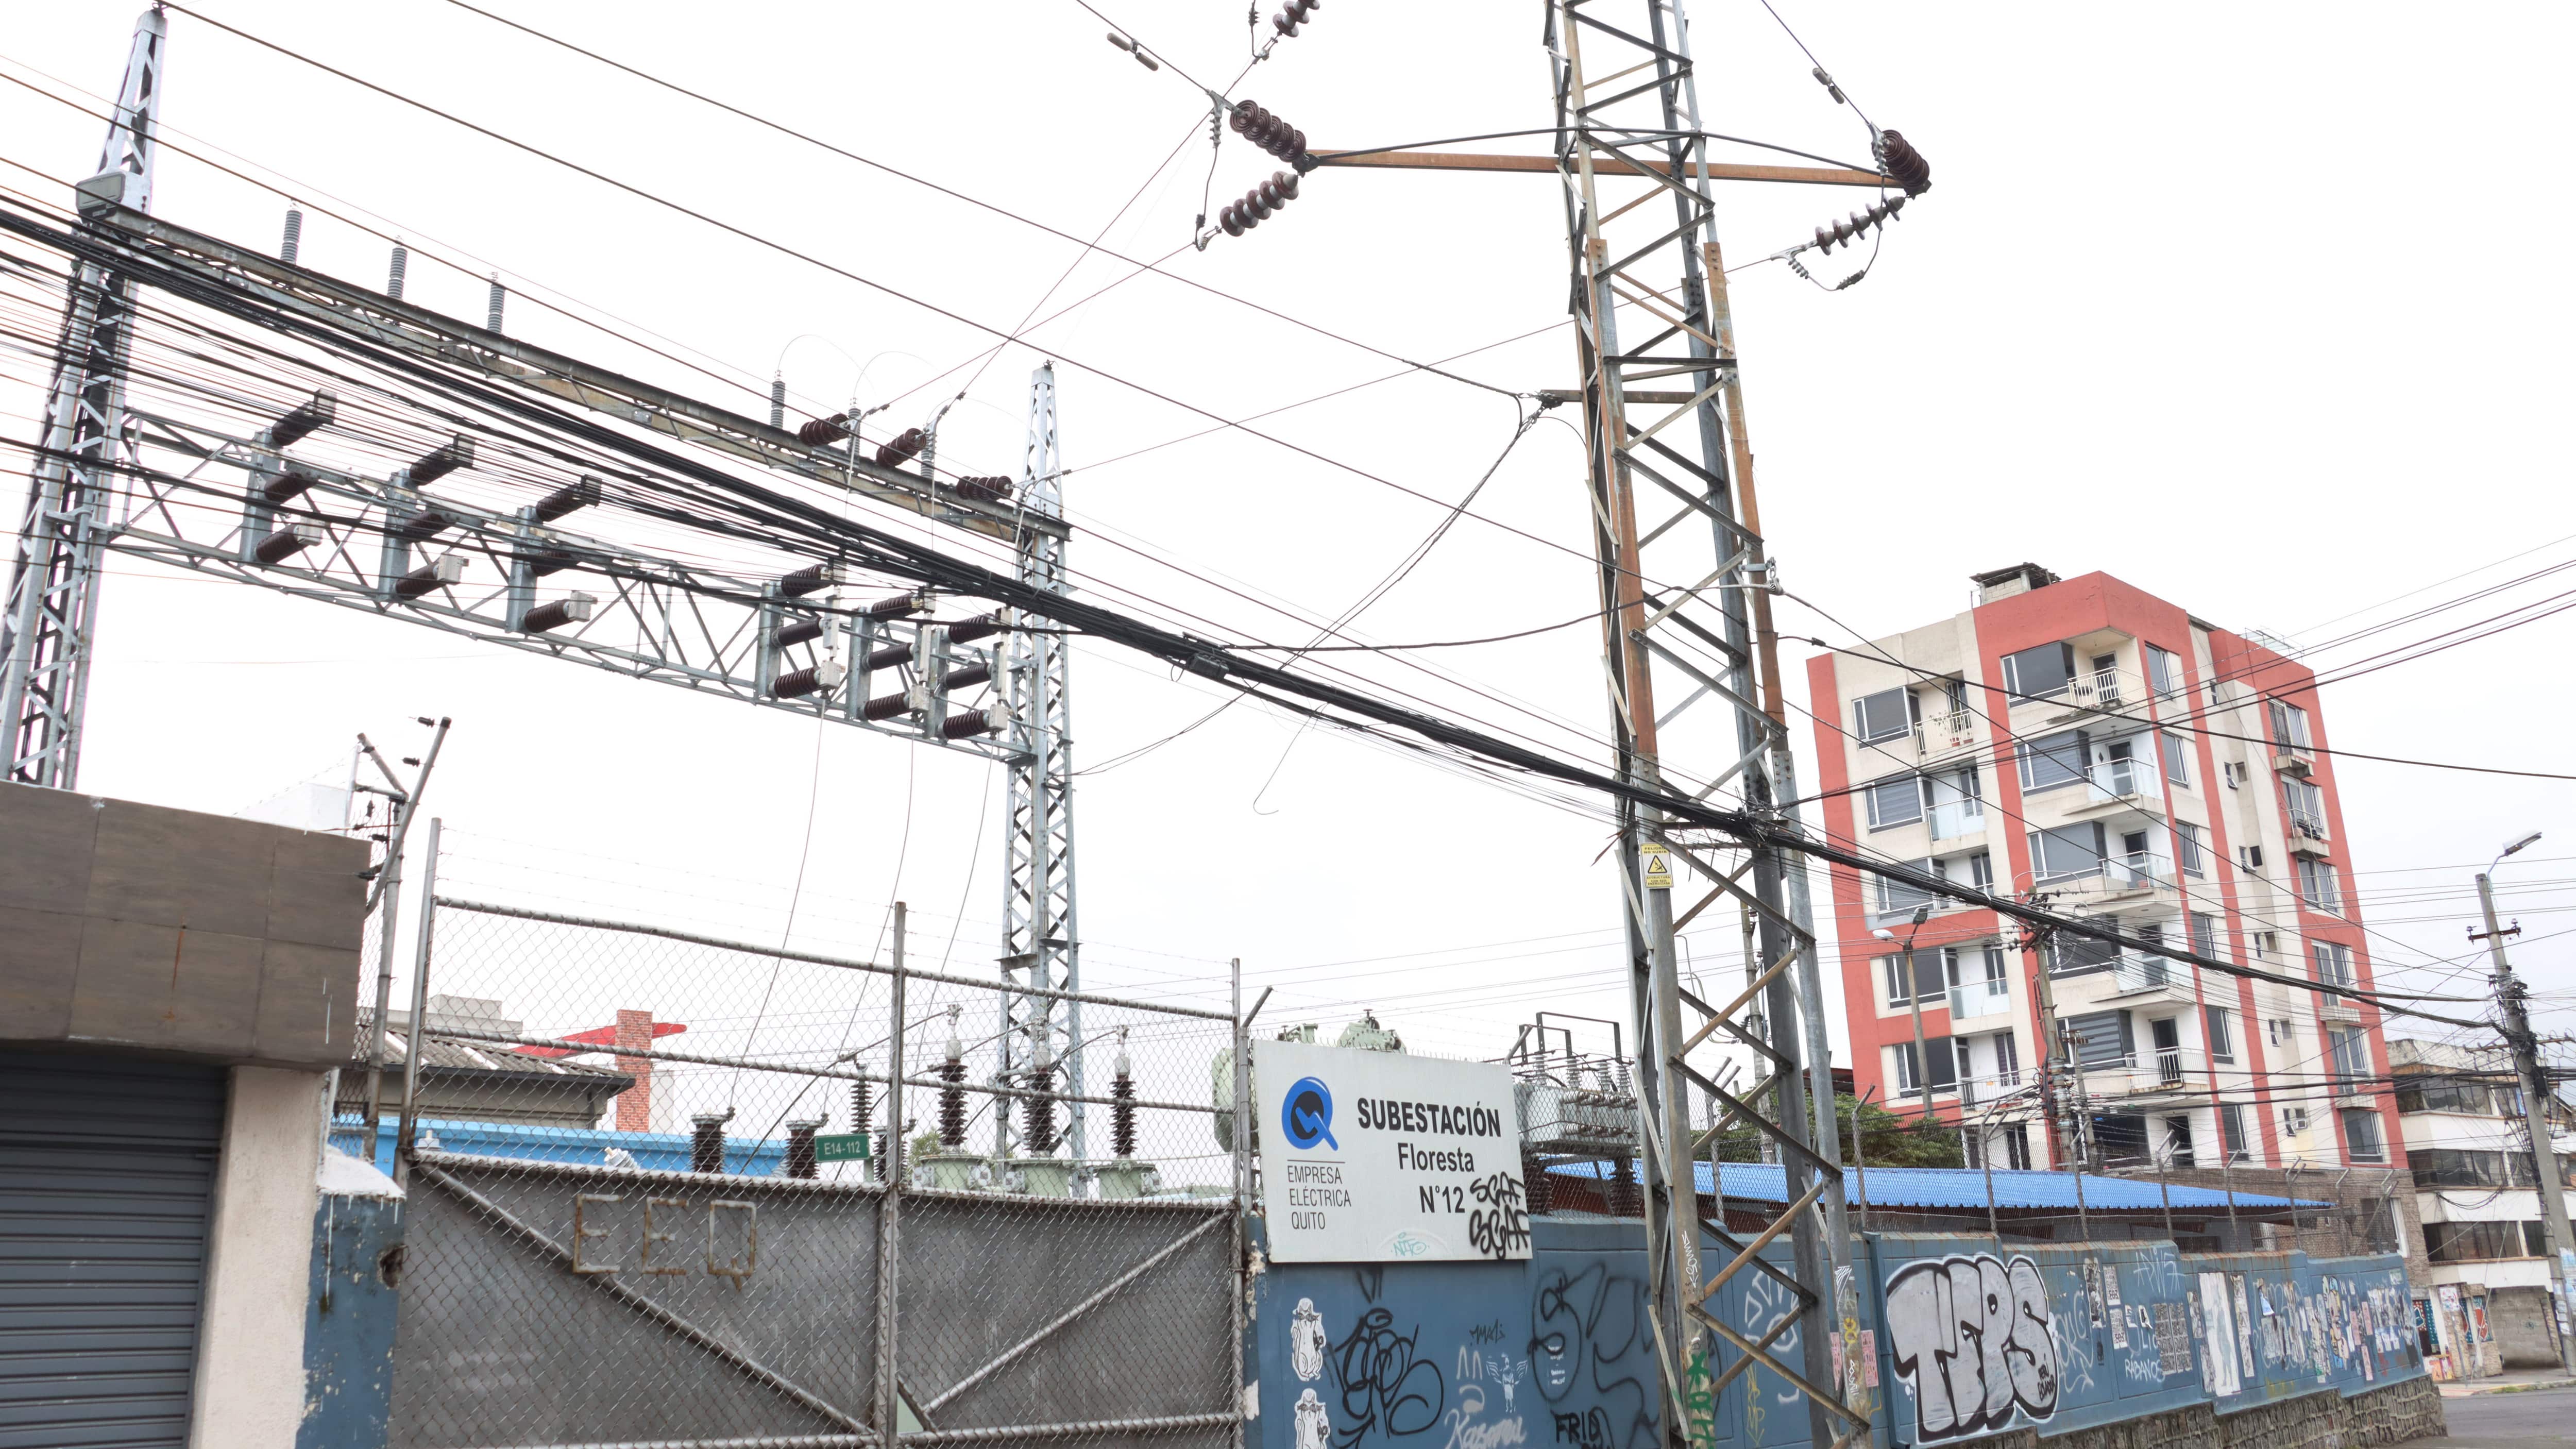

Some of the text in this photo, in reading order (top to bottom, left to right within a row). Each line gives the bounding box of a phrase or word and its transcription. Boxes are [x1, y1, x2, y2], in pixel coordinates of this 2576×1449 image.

[1357, 1098, 1502, 1137] SUBESTACIÓN
[824, 1141, 861, 1155] E14-112
[1398, 1142, 1475, 1172] Floresta
[1287, 1165, 1343, 1185] EMPRESA
[1290, 1186, 1352, 1207] ELÉCTRICA
[1291, 1211, 1326, 1230] QUITO
